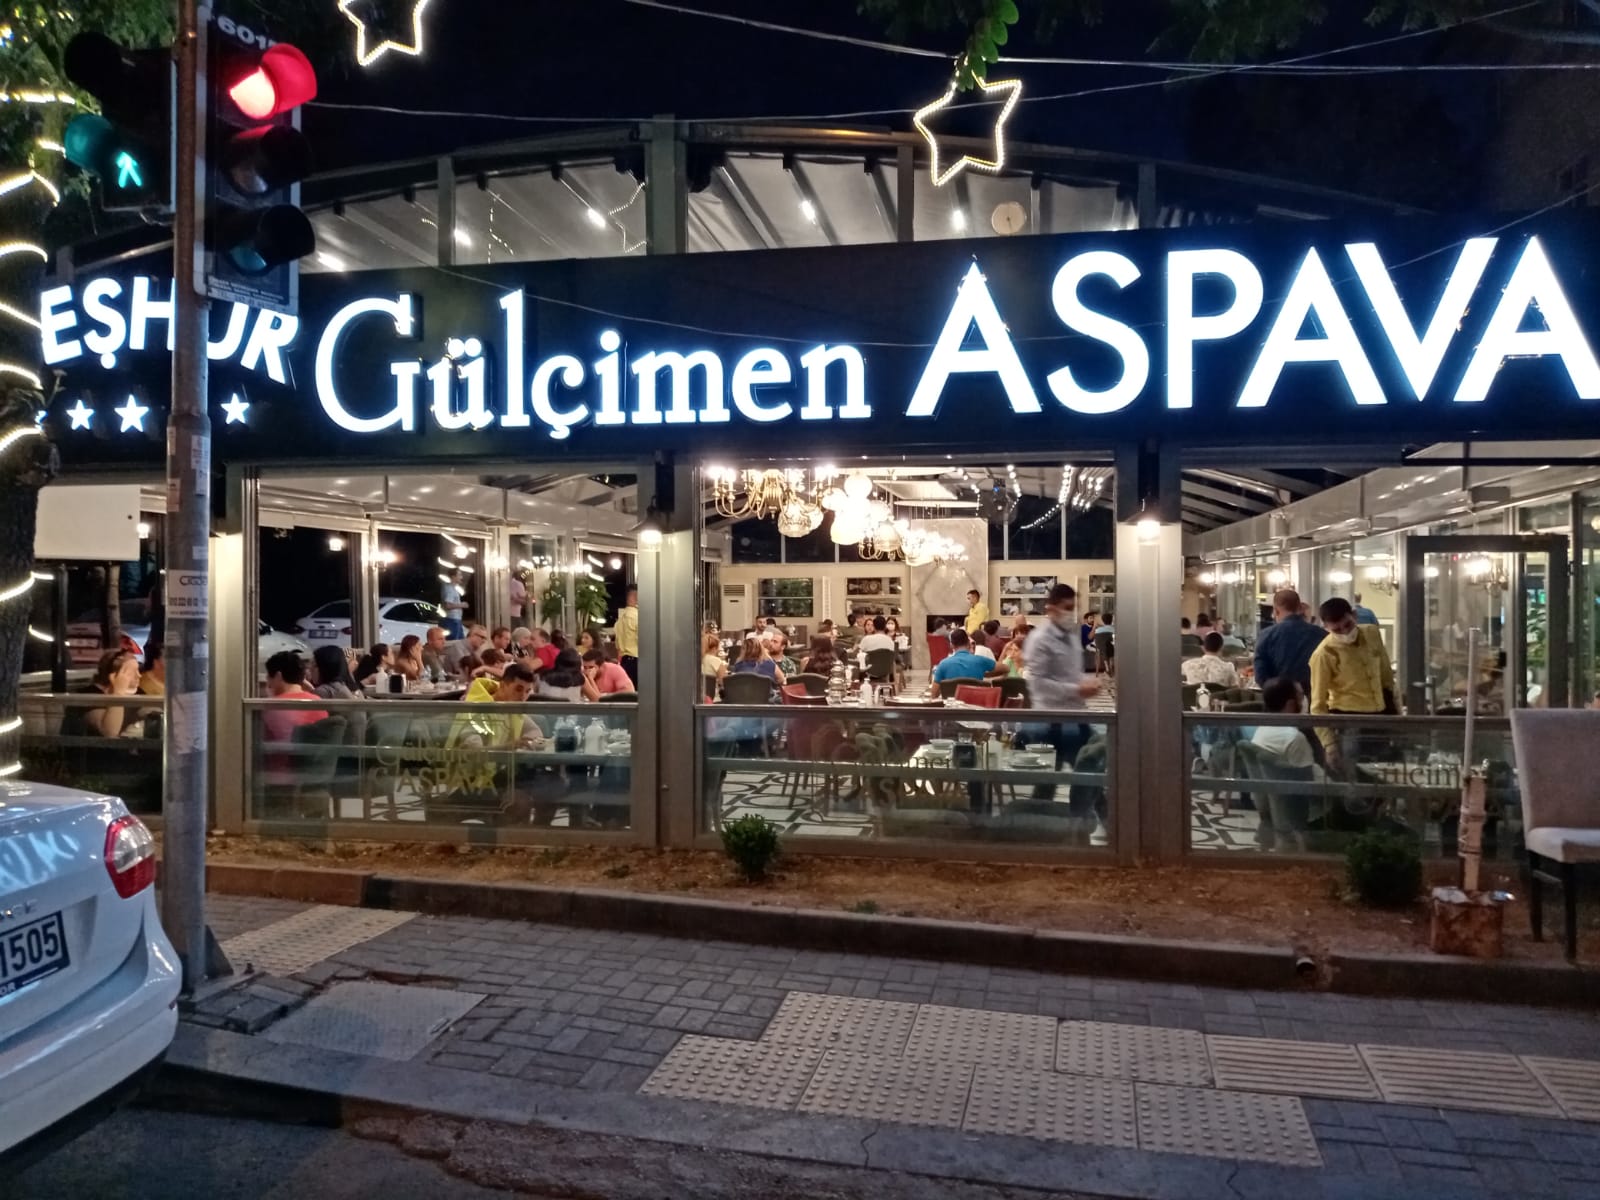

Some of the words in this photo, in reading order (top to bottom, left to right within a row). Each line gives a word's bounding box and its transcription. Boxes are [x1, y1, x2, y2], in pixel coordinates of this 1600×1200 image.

[217, 15, 277, 50] 601
[315, 289, 872, 439] Gülçimen
[905, 236, 1600, 416] ASPAVA
